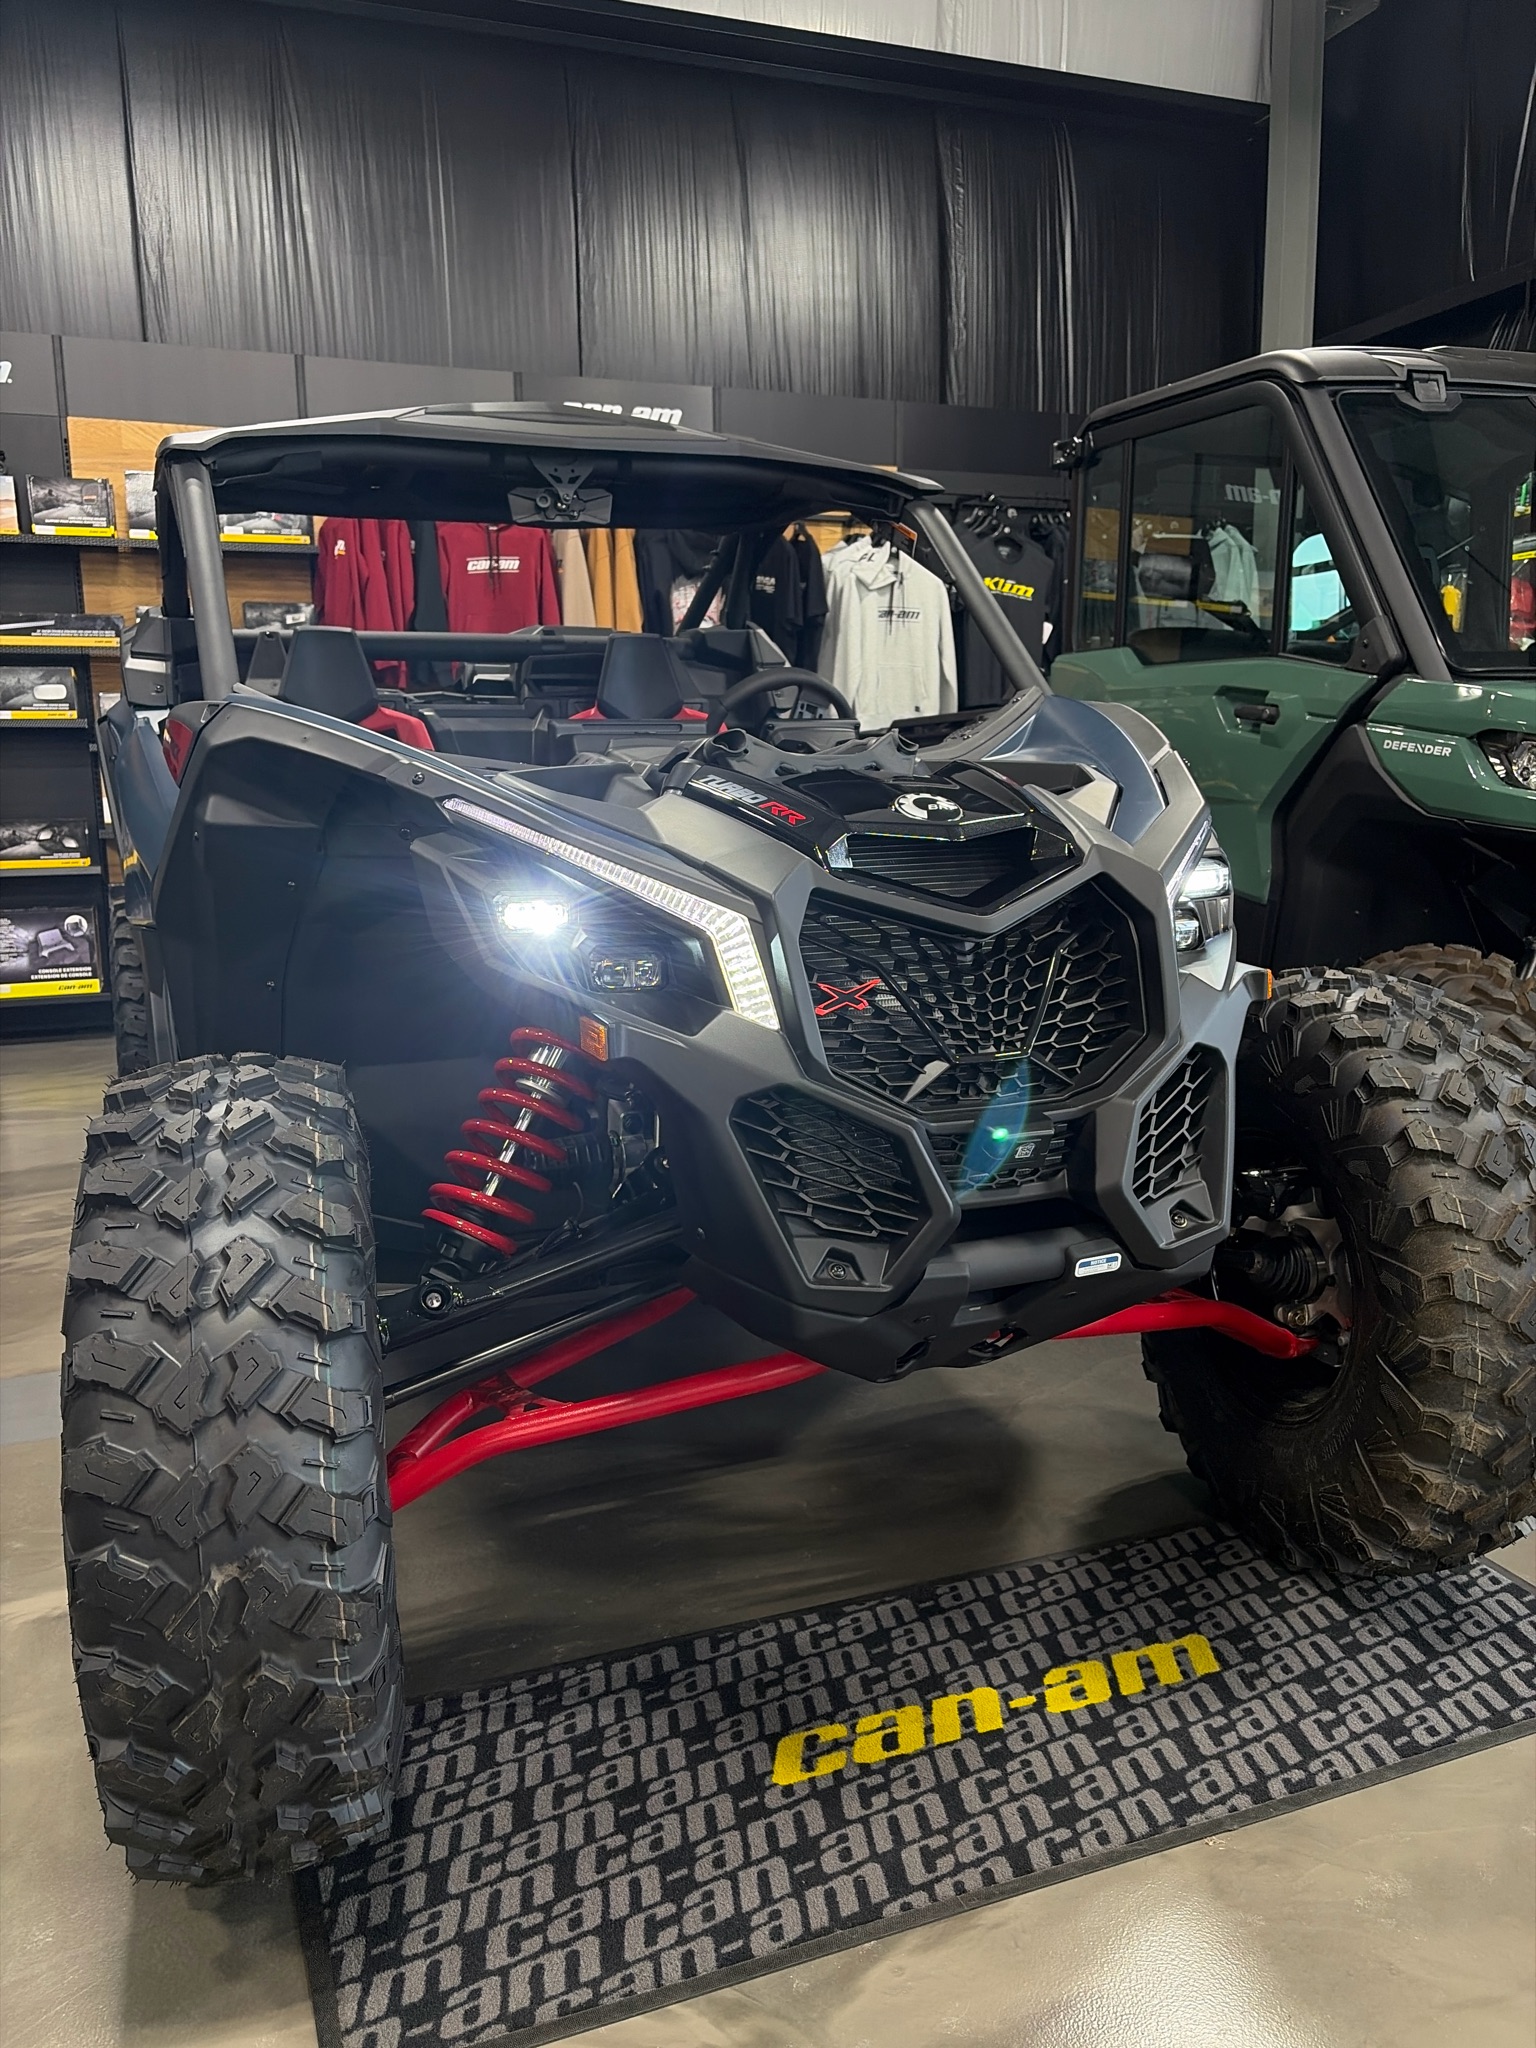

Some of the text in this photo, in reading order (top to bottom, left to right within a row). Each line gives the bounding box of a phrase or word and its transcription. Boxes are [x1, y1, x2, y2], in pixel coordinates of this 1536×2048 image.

[698, 774, 806, 826] TURBO RR
[1383, 740, 1452, 757] DEFENDER
[330, 1801, 513, 1890] -am
[535, 1688, 831, 1821] can-am
[846, 1599, 1088, 1703] can-am
[1095, 1538, 1253, 1611] can-a
[414, 1694, 721, 1827] can-am
[741, 1602, 993, 1706] can-am
[1001, 1526, 1215, 1615] can-am
[449, 1744, 772, 1894] can-am
[1057, 1561, 1278, 1657] can-am
[498, 1564, 1035, 1763] can-am can-am
[626, 1793, 948, 1962] can-am
[960, 1684, 1223, 1813] can-am
[1224, 1592, 1444, 1700] can-am
[772, 1636, 1216, 1785] can-am
[904, 1738, 1187, 1885] can-am
[1190, 1638, 1425, 1756] can-am
[1028, 1633, 1525, 1872] can-am can-am
[488, 1800, 826, 1970] can-am
